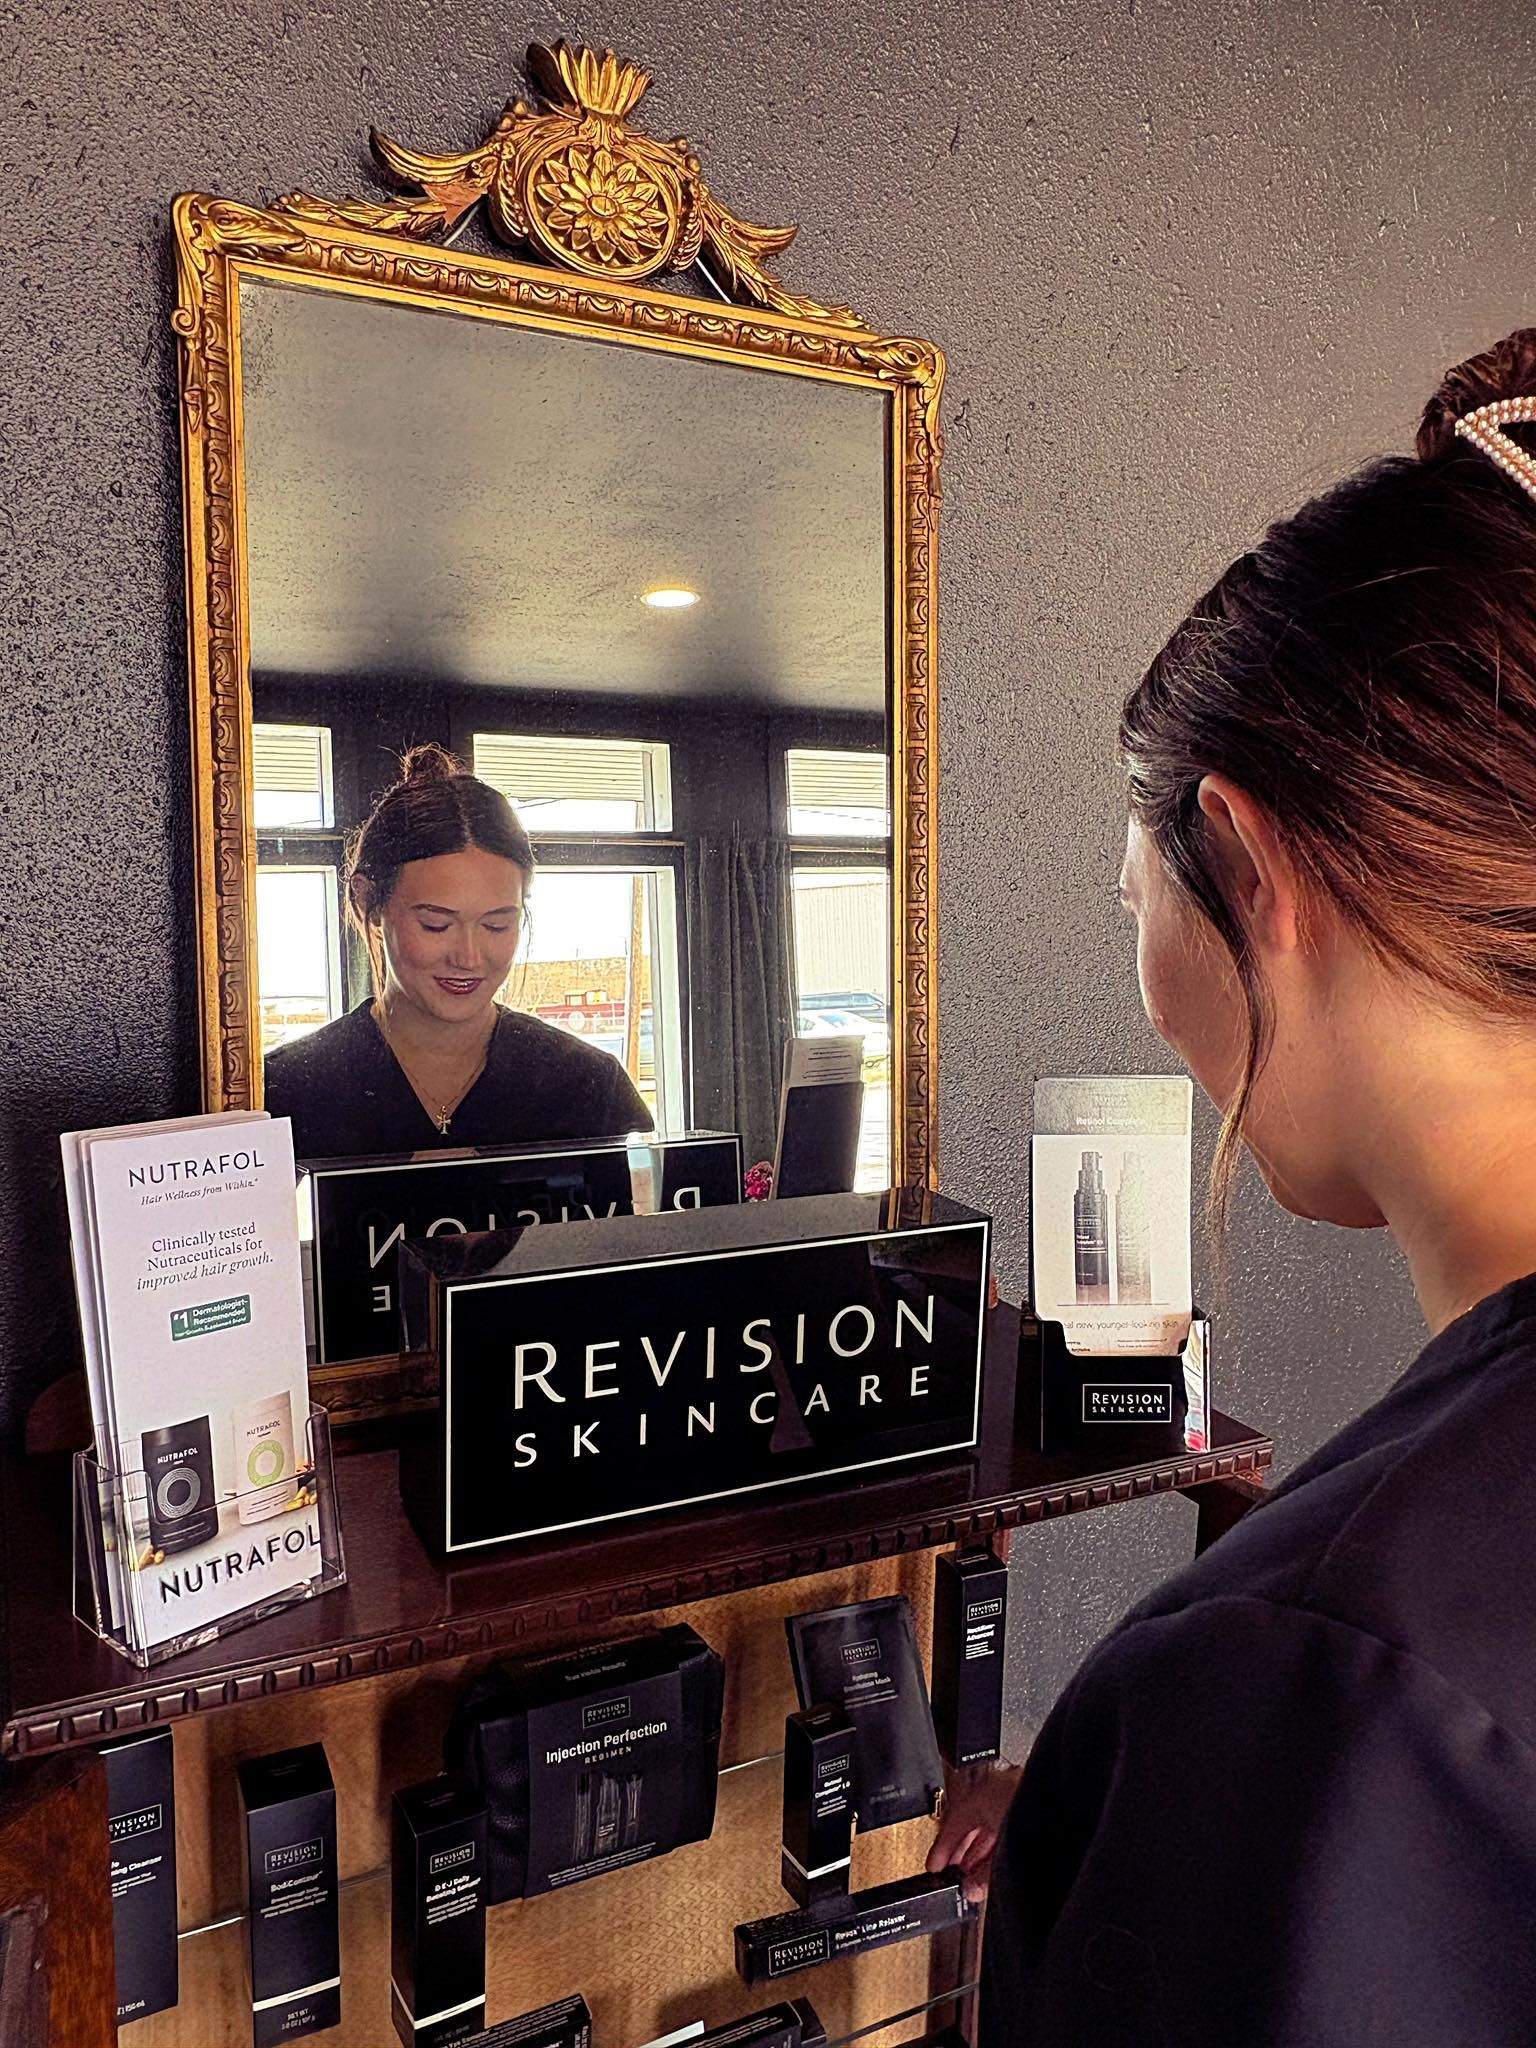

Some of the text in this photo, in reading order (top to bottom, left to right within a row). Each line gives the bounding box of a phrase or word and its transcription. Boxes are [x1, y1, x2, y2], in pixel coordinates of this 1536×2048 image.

[128, 1149, 265, 1188] NUTRAFOL
[141, 1194, 163, 1206] Hair
[165, 1188, 201, 1203] Wellness
[201, 1184, 222, 1199] from
[152, 1221, 256, 1254] Clinically tested
[147, 1238, 263, 1272] Nutraceuticals for
[137, 1251, 274, 1292] improved hair growth.
[193, 1306, 246, 1326] Recommended
[513, 1294, 936, 1410] REVISION
[1092, 1392, 1163, 1405] REVISION
[512, 1364, 930, 1469] SKINCARE
[246, 1419, 281, 1437] NUTRAFOL
[157, 1447, 198, 1465] NUTRAFOL
[160, 1523, 321, 1604] NUTRAFOL
[587, 1702, 626, 1718] REVISION
[546, 1721, 668, 1765] Injection Perfection
[584, 1745, 632, 1765] REGIMEN
[861, 1922, 878, 1934] Line
[774, 1939, 824, 1960] REVISION
